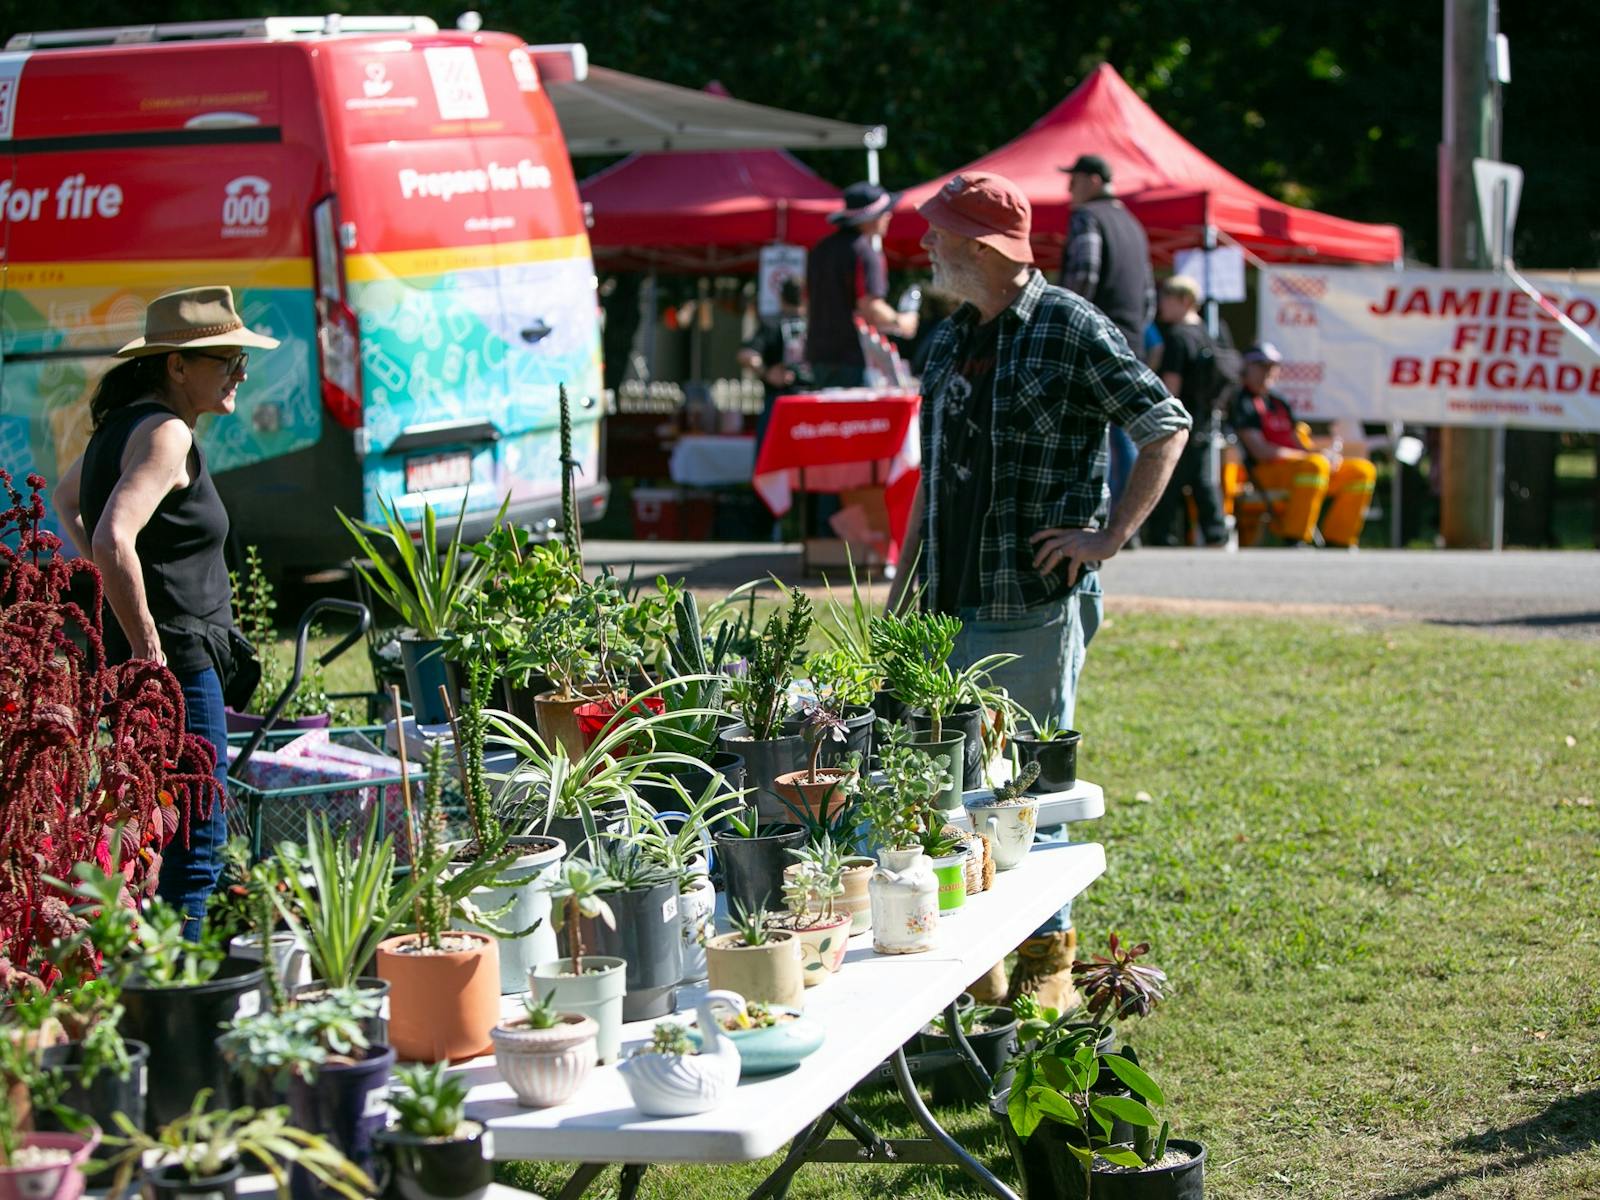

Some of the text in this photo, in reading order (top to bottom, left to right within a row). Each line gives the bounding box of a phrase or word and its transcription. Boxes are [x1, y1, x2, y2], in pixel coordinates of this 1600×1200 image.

[55, 173, 124, 219] fire
[399, 168, 487, 202] Prepare
[487, 161, 518, 190] for
[223, 195, 270, 225] 000
[1369, 286, 1600, 326] JAMIESO
[1452, 325, 1564, 357] FIRE
